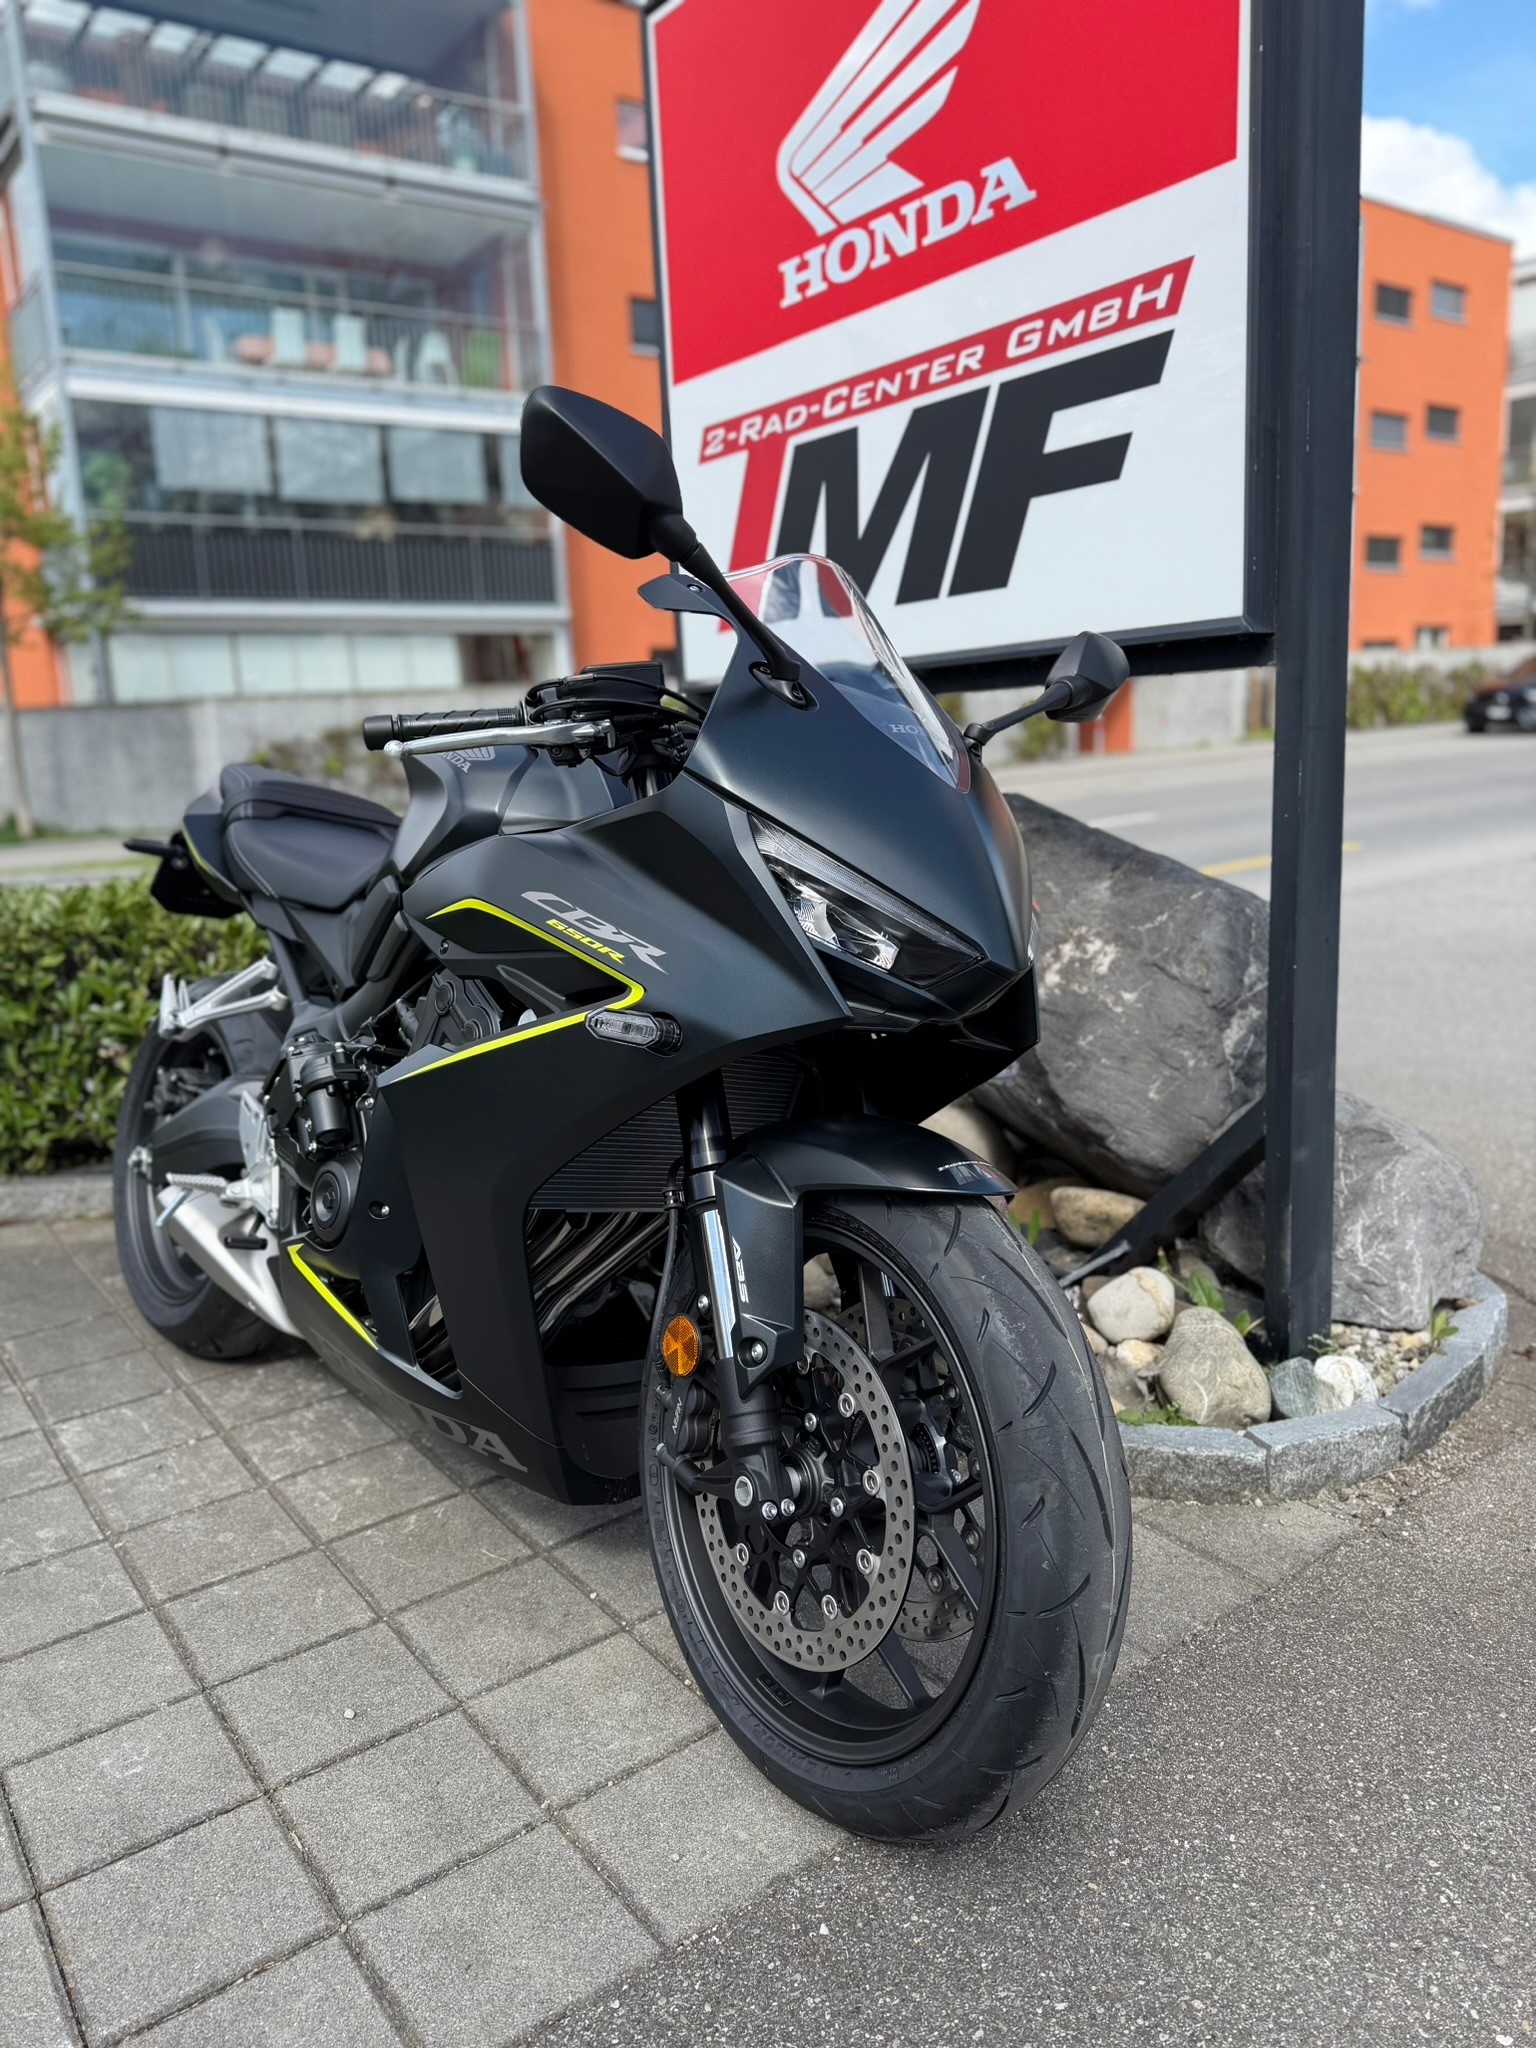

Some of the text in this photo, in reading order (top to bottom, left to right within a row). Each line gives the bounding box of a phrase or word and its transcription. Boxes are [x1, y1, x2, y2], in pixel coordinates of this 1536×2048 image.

[778, 156, 1037, 309] HONDA
[699, 328, 1175, 634] TMF
[521, 891, 669, 975] CBR
[546, 918, 626, 965] 650R
[732, 1236, 749, 1304] ABS
